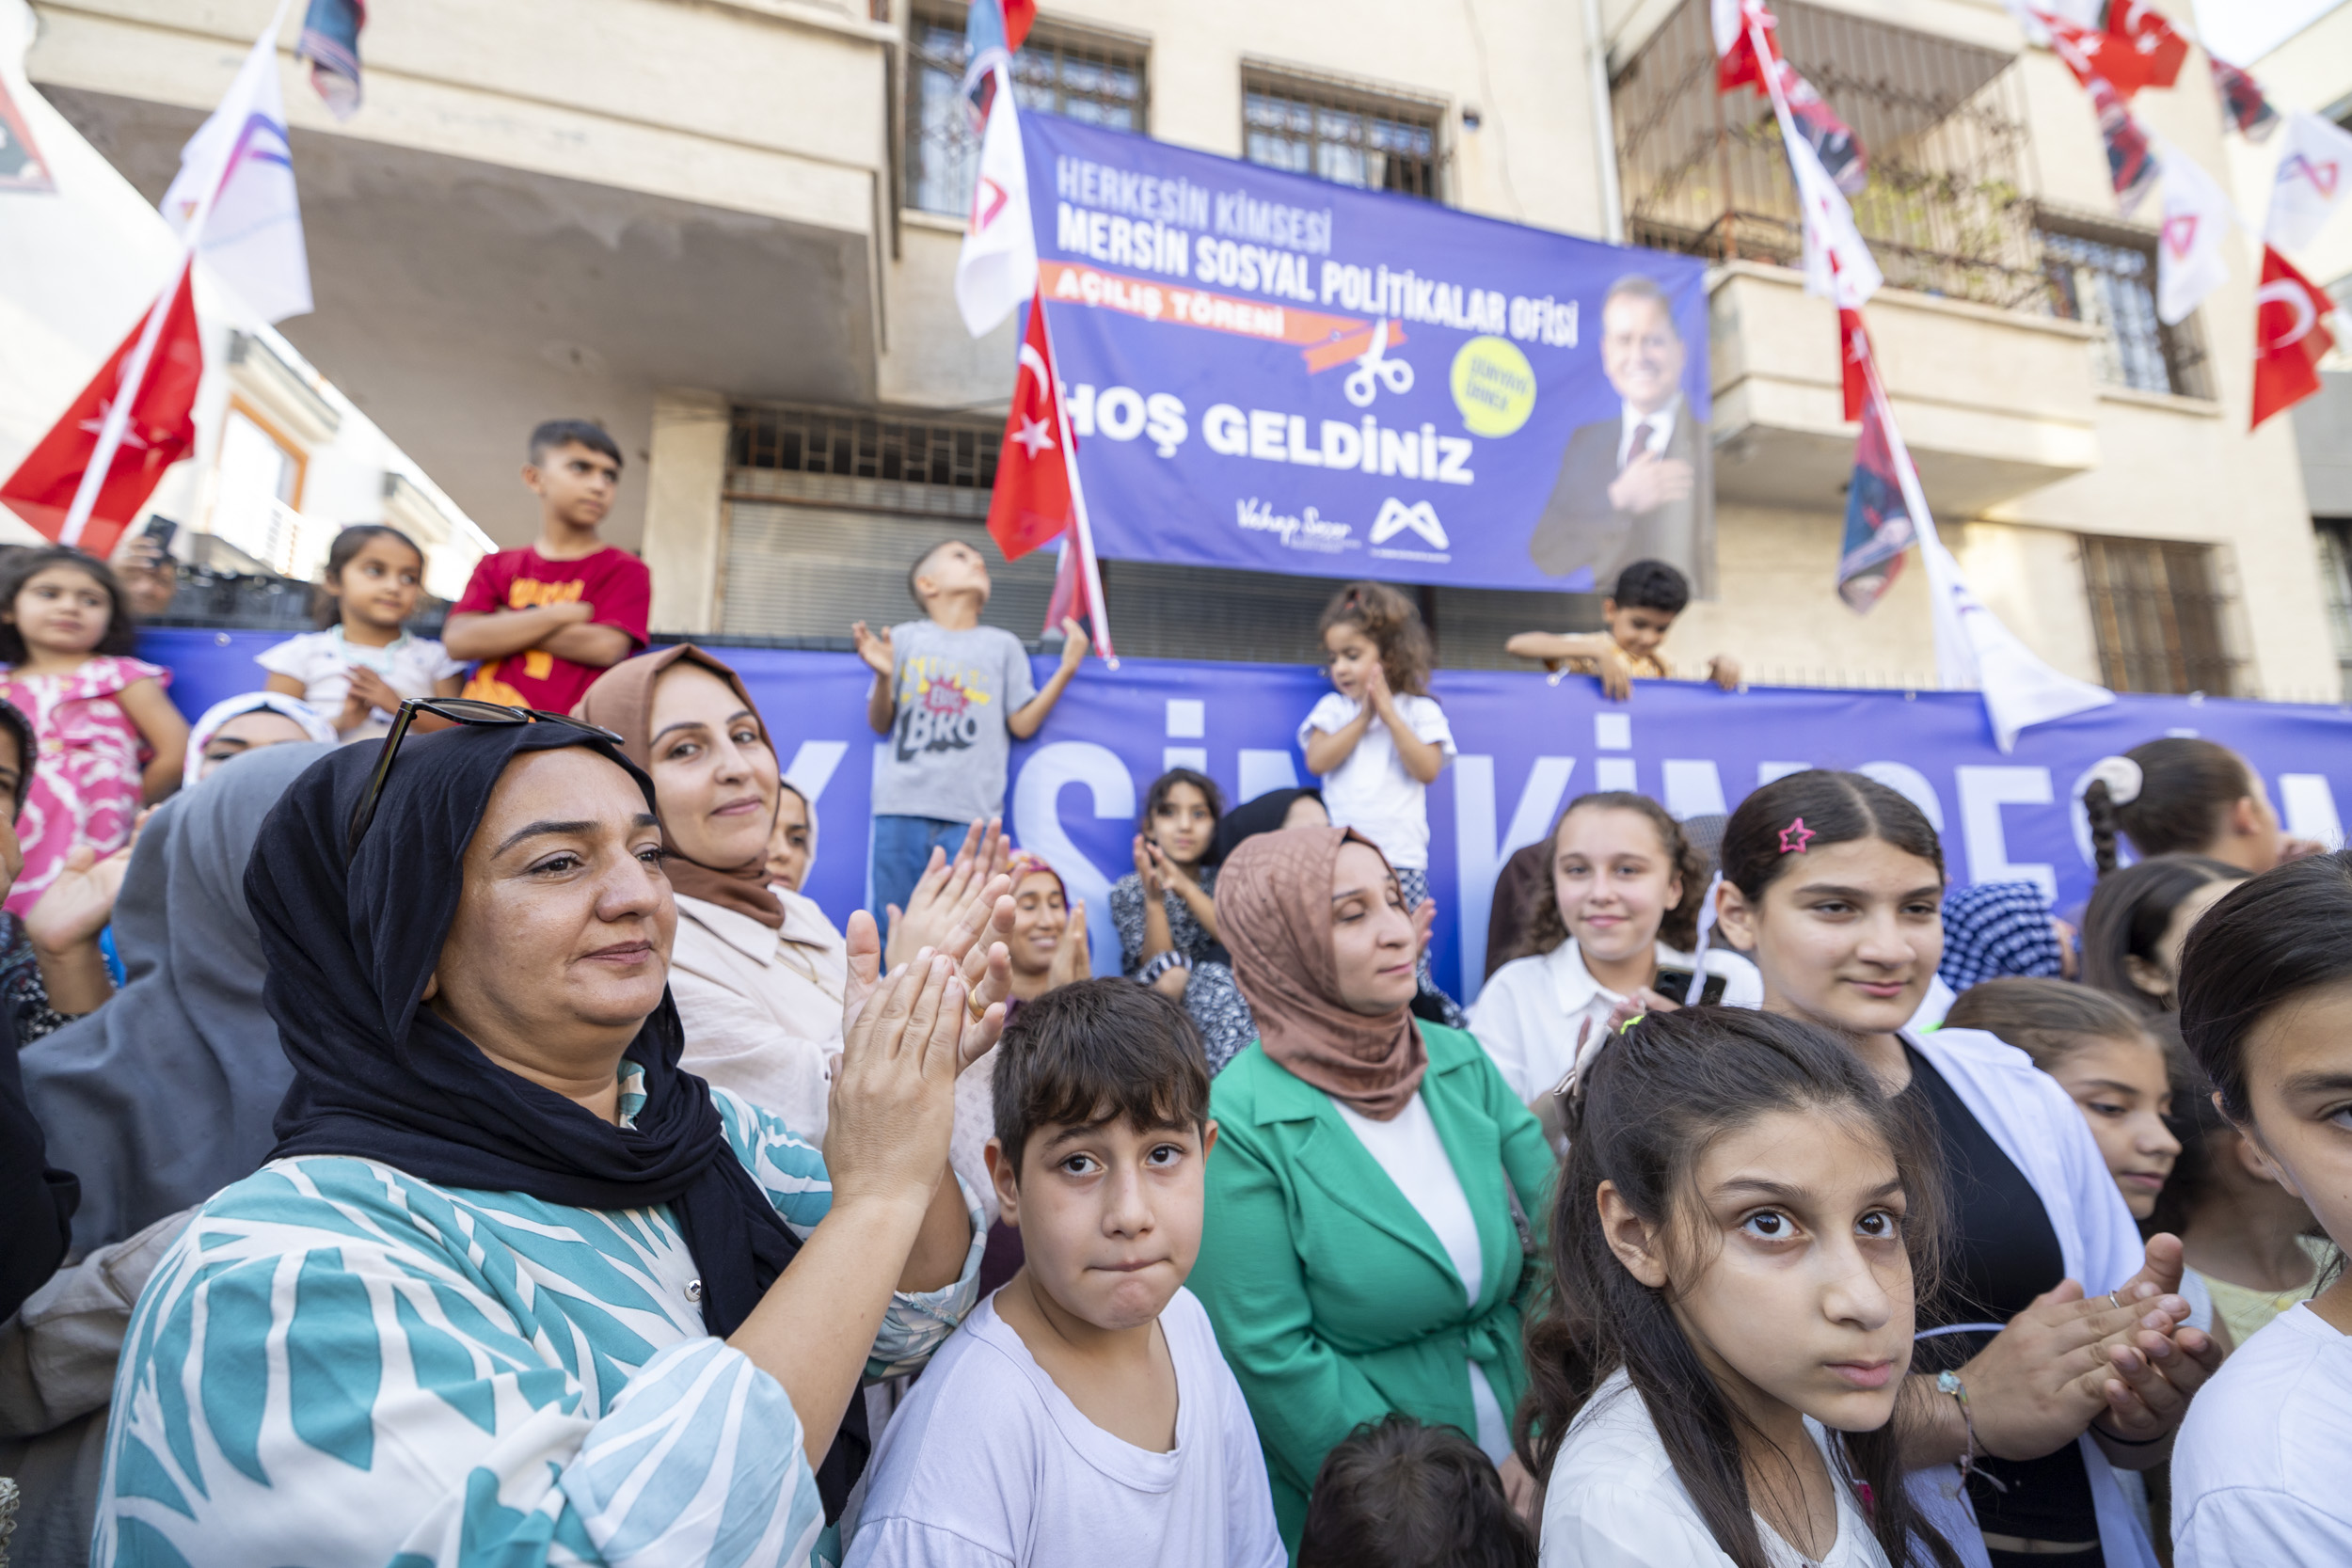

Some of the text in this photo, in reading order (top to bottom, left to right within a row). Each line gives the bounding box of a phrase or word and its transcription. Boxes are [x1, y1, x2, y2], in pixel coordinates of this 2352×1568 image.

[1057, 154, 1333, 256] HERKESİN KİMSESİ
[1055, 267, 1285, 339] AÇILIŞ TÖRENİ
[1057, 200, 1581, 349] MERSİN SOSYAL POLİTİKALAR OFİSİ
[1061, 381, 1475, 485] HOŞ GELDİNİZ
[901, 707, 980, 752] BRO
